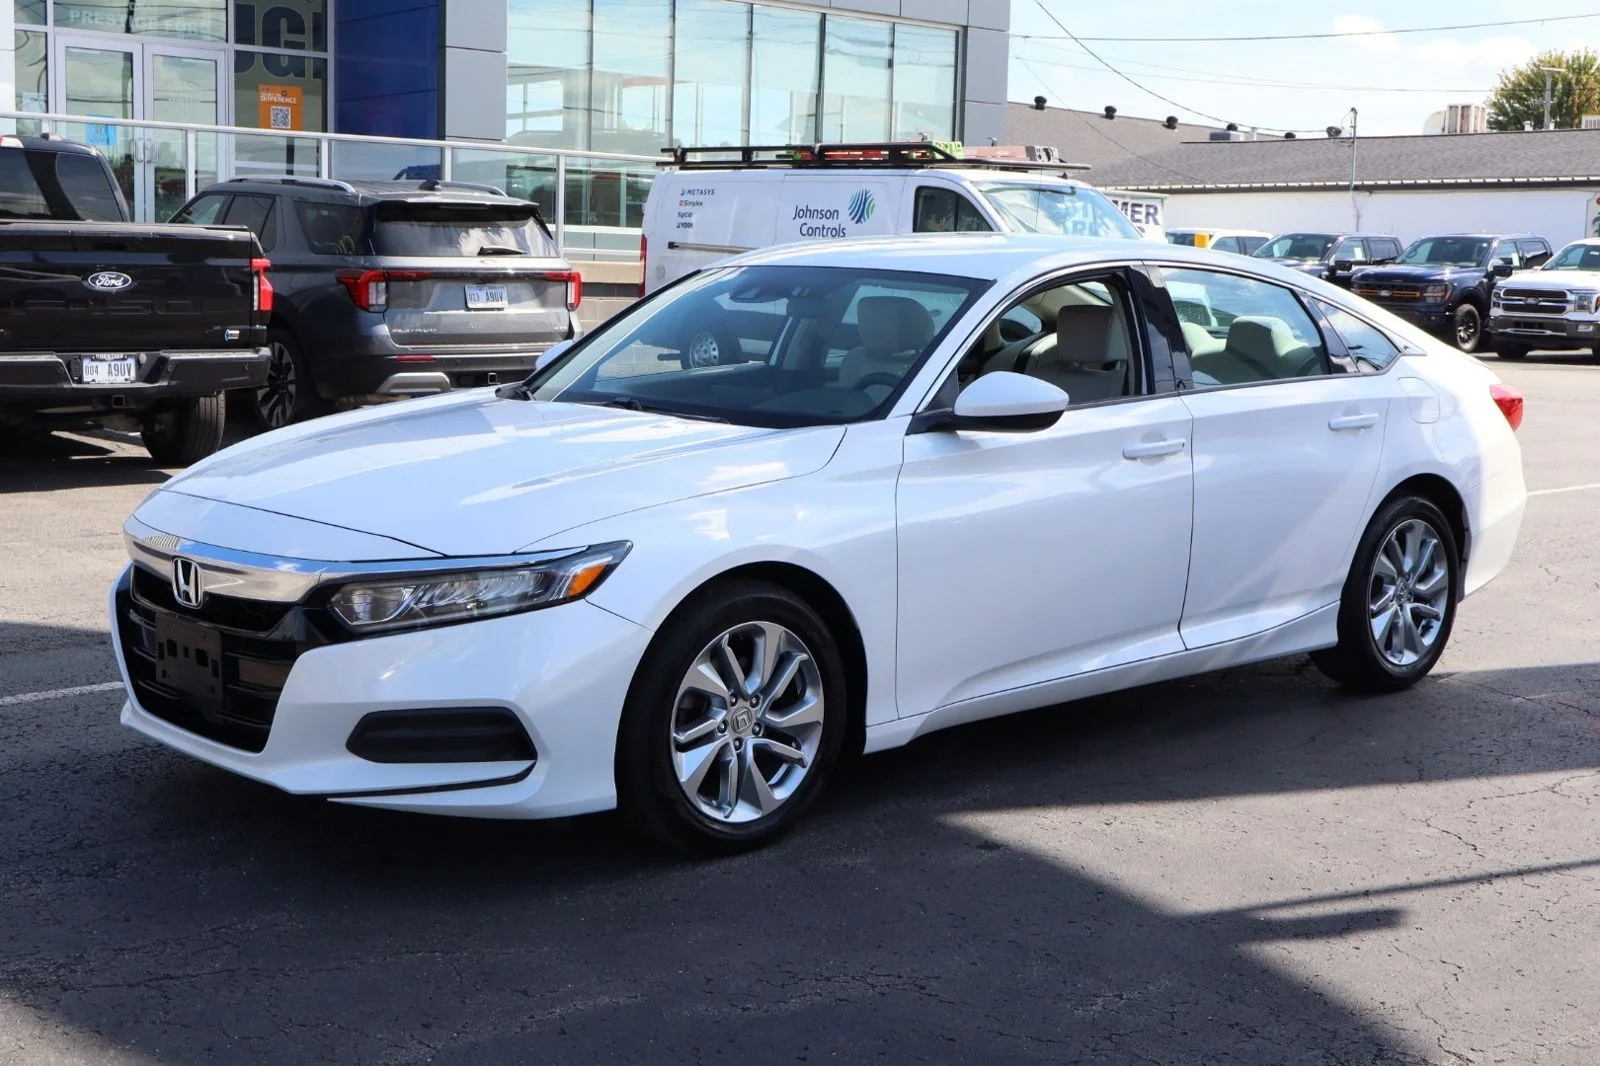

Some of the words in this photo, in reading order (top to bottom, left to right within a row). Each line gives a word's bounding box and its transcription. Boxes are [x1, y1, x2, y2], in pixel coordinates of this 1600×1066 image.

[687, 188, 716, 196] METASYS
[793, 204, 840, 220] Johnson
[799, 222, 847, 238] Controls
[95, 274, 124, 287] Ford
[107, 362, 132, 378] A9UV
